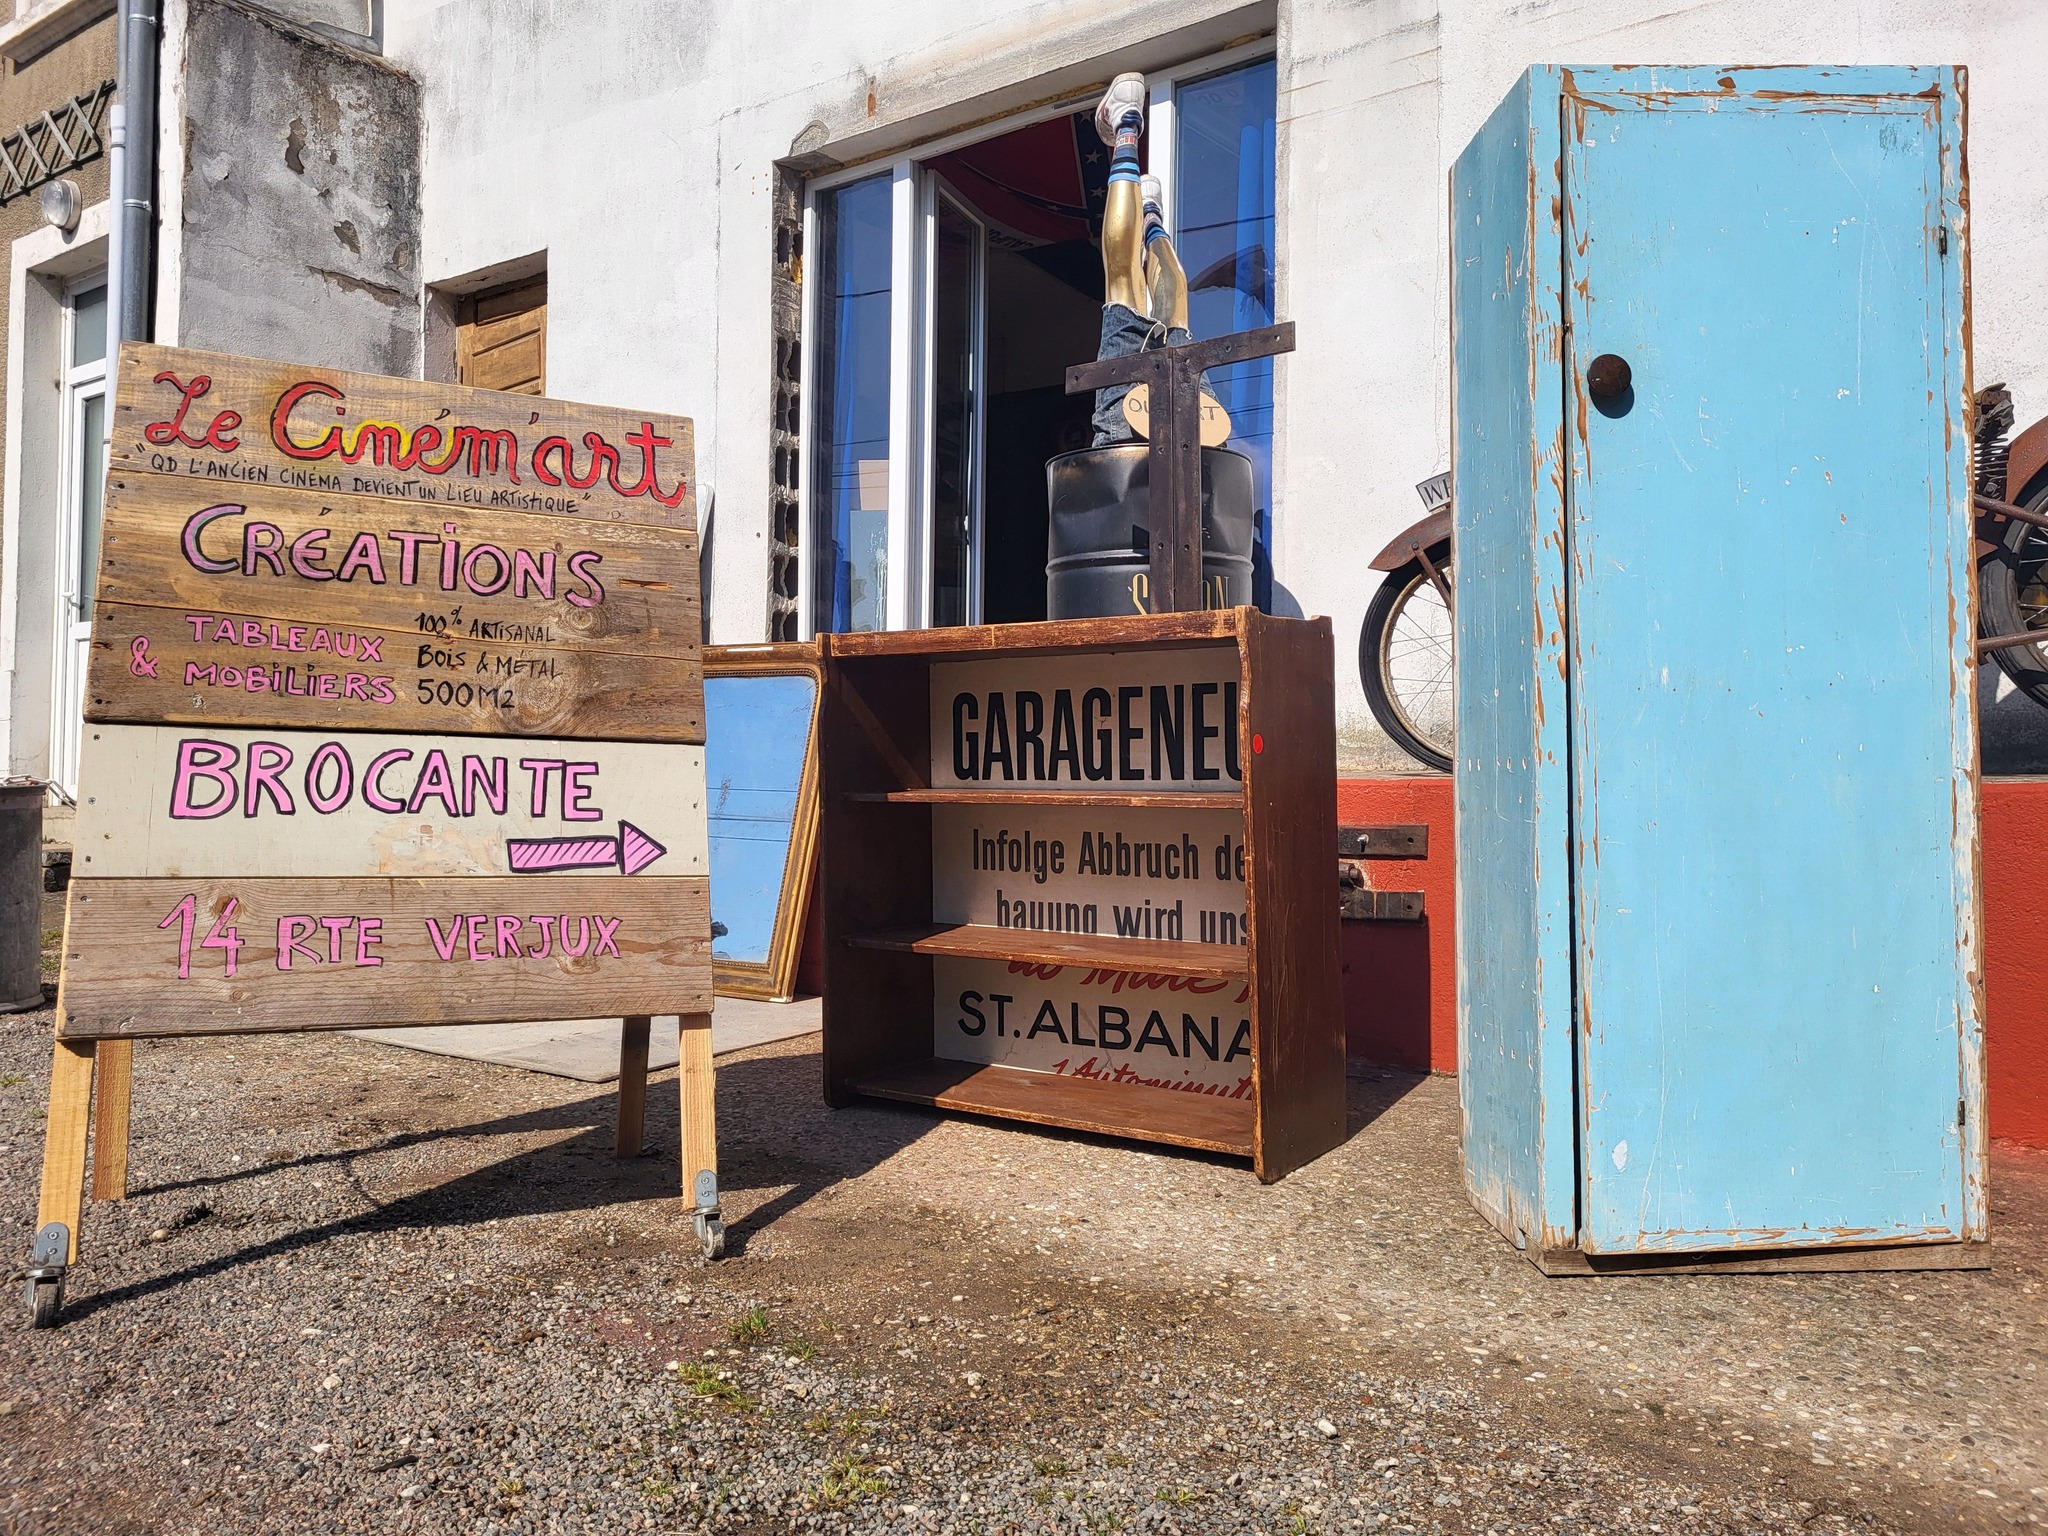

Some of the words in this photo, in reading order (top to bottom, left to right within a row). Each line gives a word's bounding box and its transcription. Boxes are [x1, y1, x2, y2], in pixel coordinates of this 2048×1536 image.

[144, 371, 242, 452] Le
[185, 615, 384, 662] TABLEAUX
[414, 605, 462, 634] 100%
[130, 637, 159, 680] &
[184, 661, 397, 704] MOBILIERS
[476, 651, 489, 674] &
[495, 650, 563, 680] MÉTAL
[170, 739, 603, 821] BROCANTE
[973, 829, 1064, 884] Infolge
[1078, 832, 1199, 880] Abbruch
[157, 894, 245, 980] 14
[275, 914, 383, 972] RTE
[425, 914, 623, 962] VERJUX
[1113, 899, 1183, 941] wird
